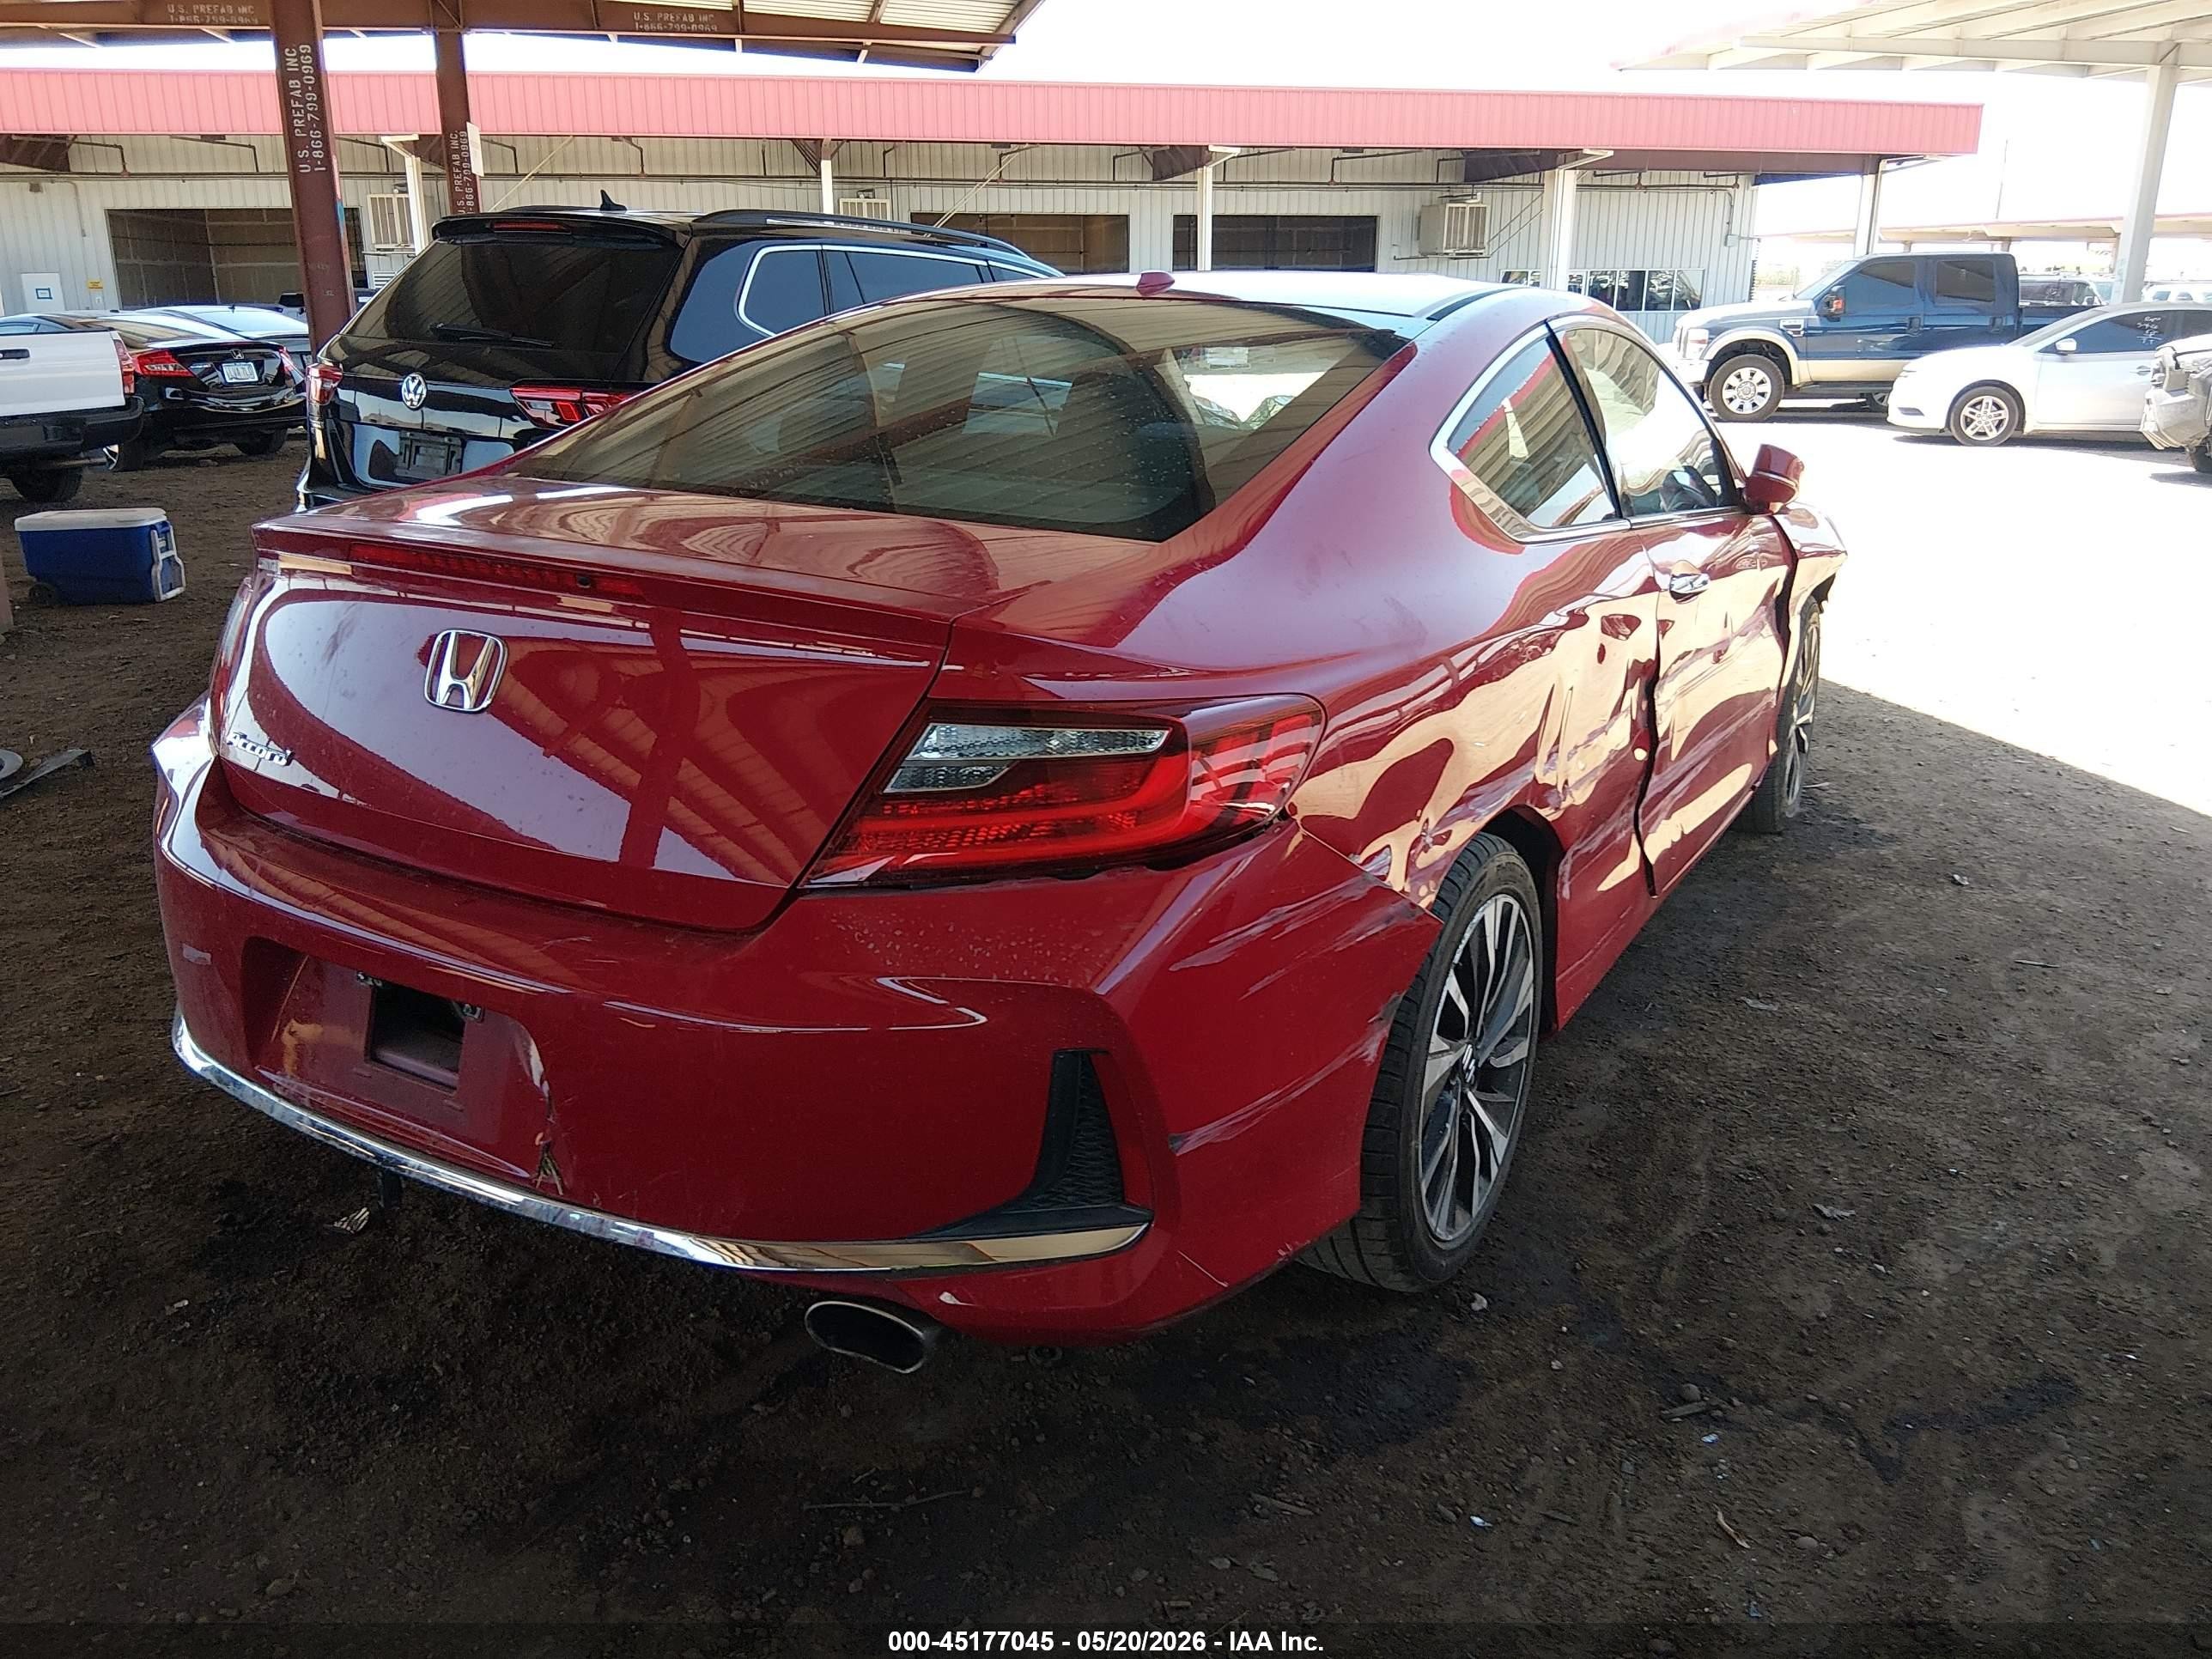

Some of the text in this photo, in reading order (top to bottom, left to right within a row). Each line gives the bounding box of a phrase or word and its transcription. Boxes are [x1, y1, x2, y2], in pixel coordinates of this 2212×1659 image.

[192, 4, 234, 15] PREFAB
[657, 12, 695, 22] PREFAB
[289, 79, 307, 137] PREFAB
[299, 44, 326, 172] 1-866-799-0969
[297, 145, 312, 173] U.S.
[452, 154, 464, 192] PREFAB
[226, 732, 293, 767] Accord
